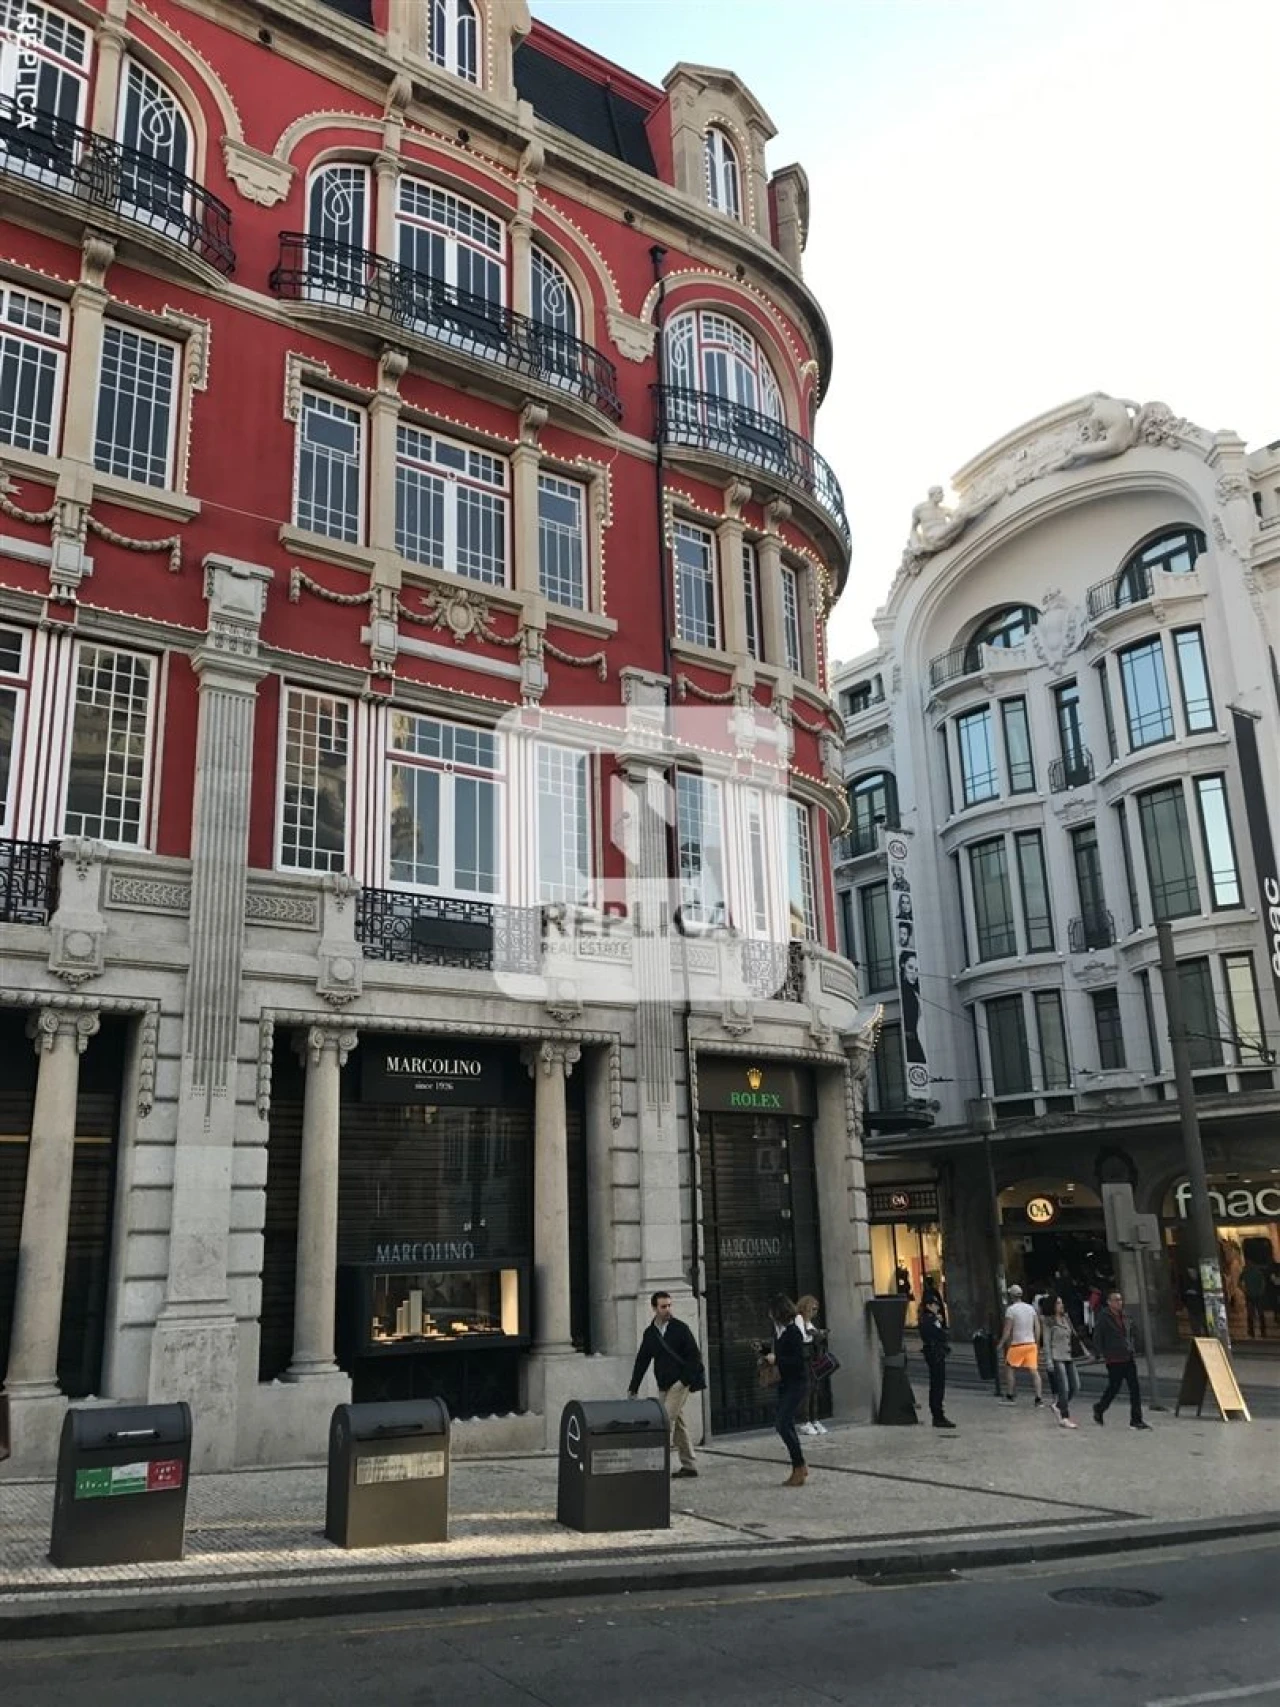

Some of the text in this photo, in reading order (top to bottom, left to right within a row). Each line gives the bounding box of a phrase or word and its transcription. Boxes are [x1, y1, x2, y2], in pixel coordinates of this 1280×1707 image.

[386, 1056, 481, 1075] MARCOLINO
[731, 1091, 782, 1108] ROLEX
[376, 1241, 475, 1262] MARCOLINO
